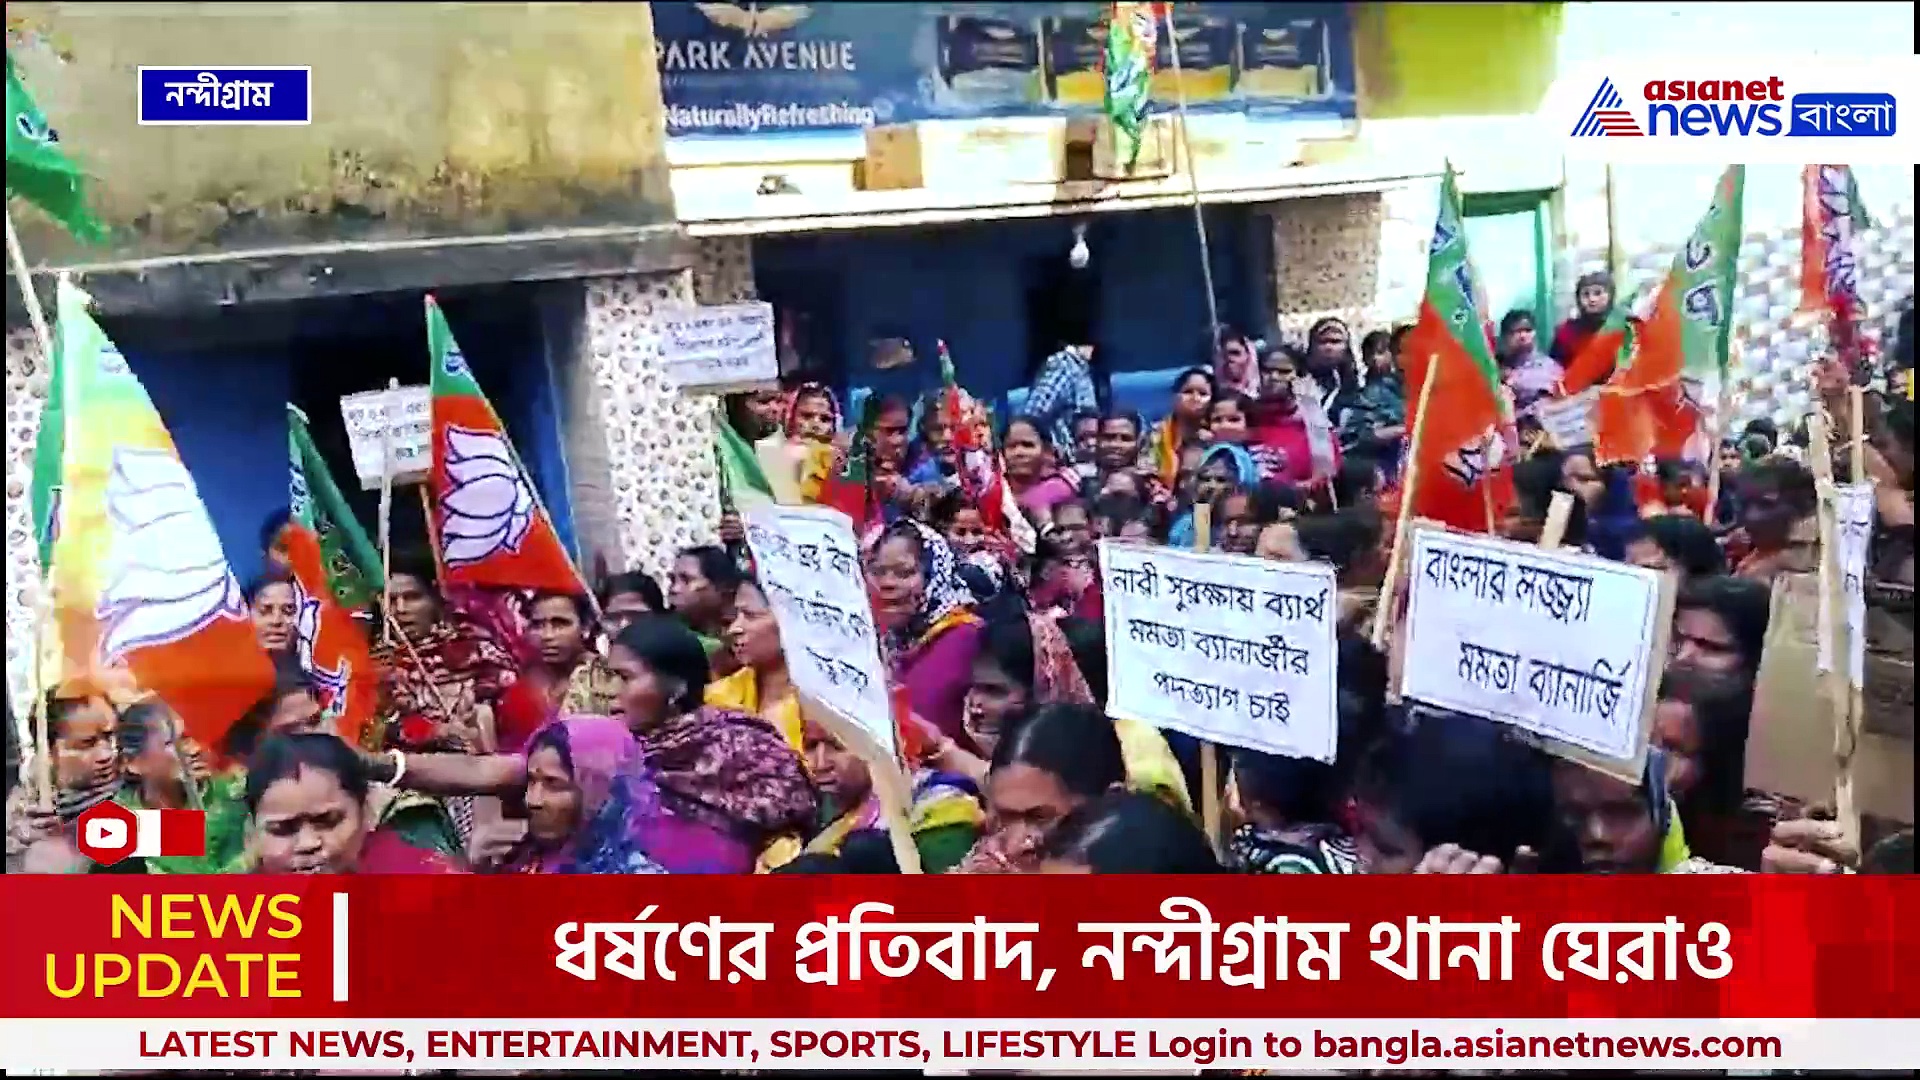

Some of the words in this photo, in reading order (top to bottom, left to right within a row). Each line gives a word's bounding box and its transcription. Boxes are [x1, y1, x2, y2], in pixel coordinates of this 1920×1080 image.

[743, 39, 857, 70] AVENUE
[1425, 547, 1508, 603] বাংলার
[1128, 618, 1186, 651] মমতা
[1458, 642, 1521, 694] মমতা
[1153, 671, 1239, 711] পদত্যাগ
